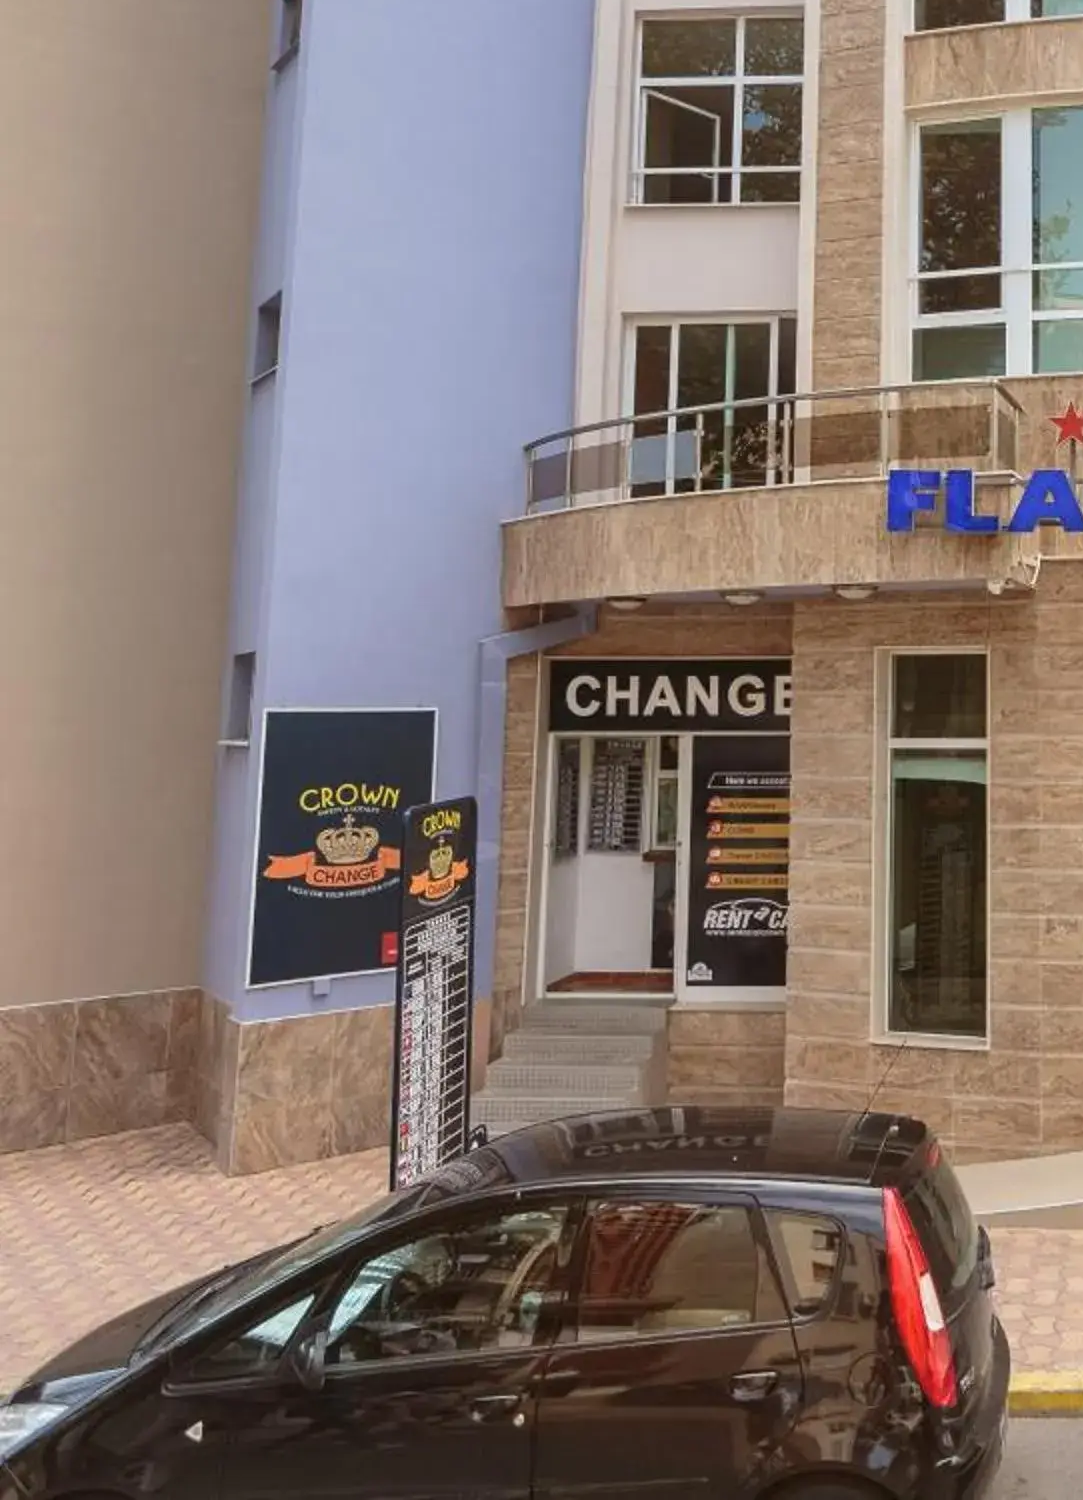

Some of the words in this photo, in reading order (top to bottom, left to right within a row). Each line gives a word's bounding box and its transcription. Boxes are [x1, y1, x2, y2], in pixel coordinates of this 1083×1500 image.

[300, 783, 400, 812] CROWN
[423, 810, 461, 837] CROWN
[313, 865, 378, 884] CHANGE
[703, 908, 754, 930] RENT
